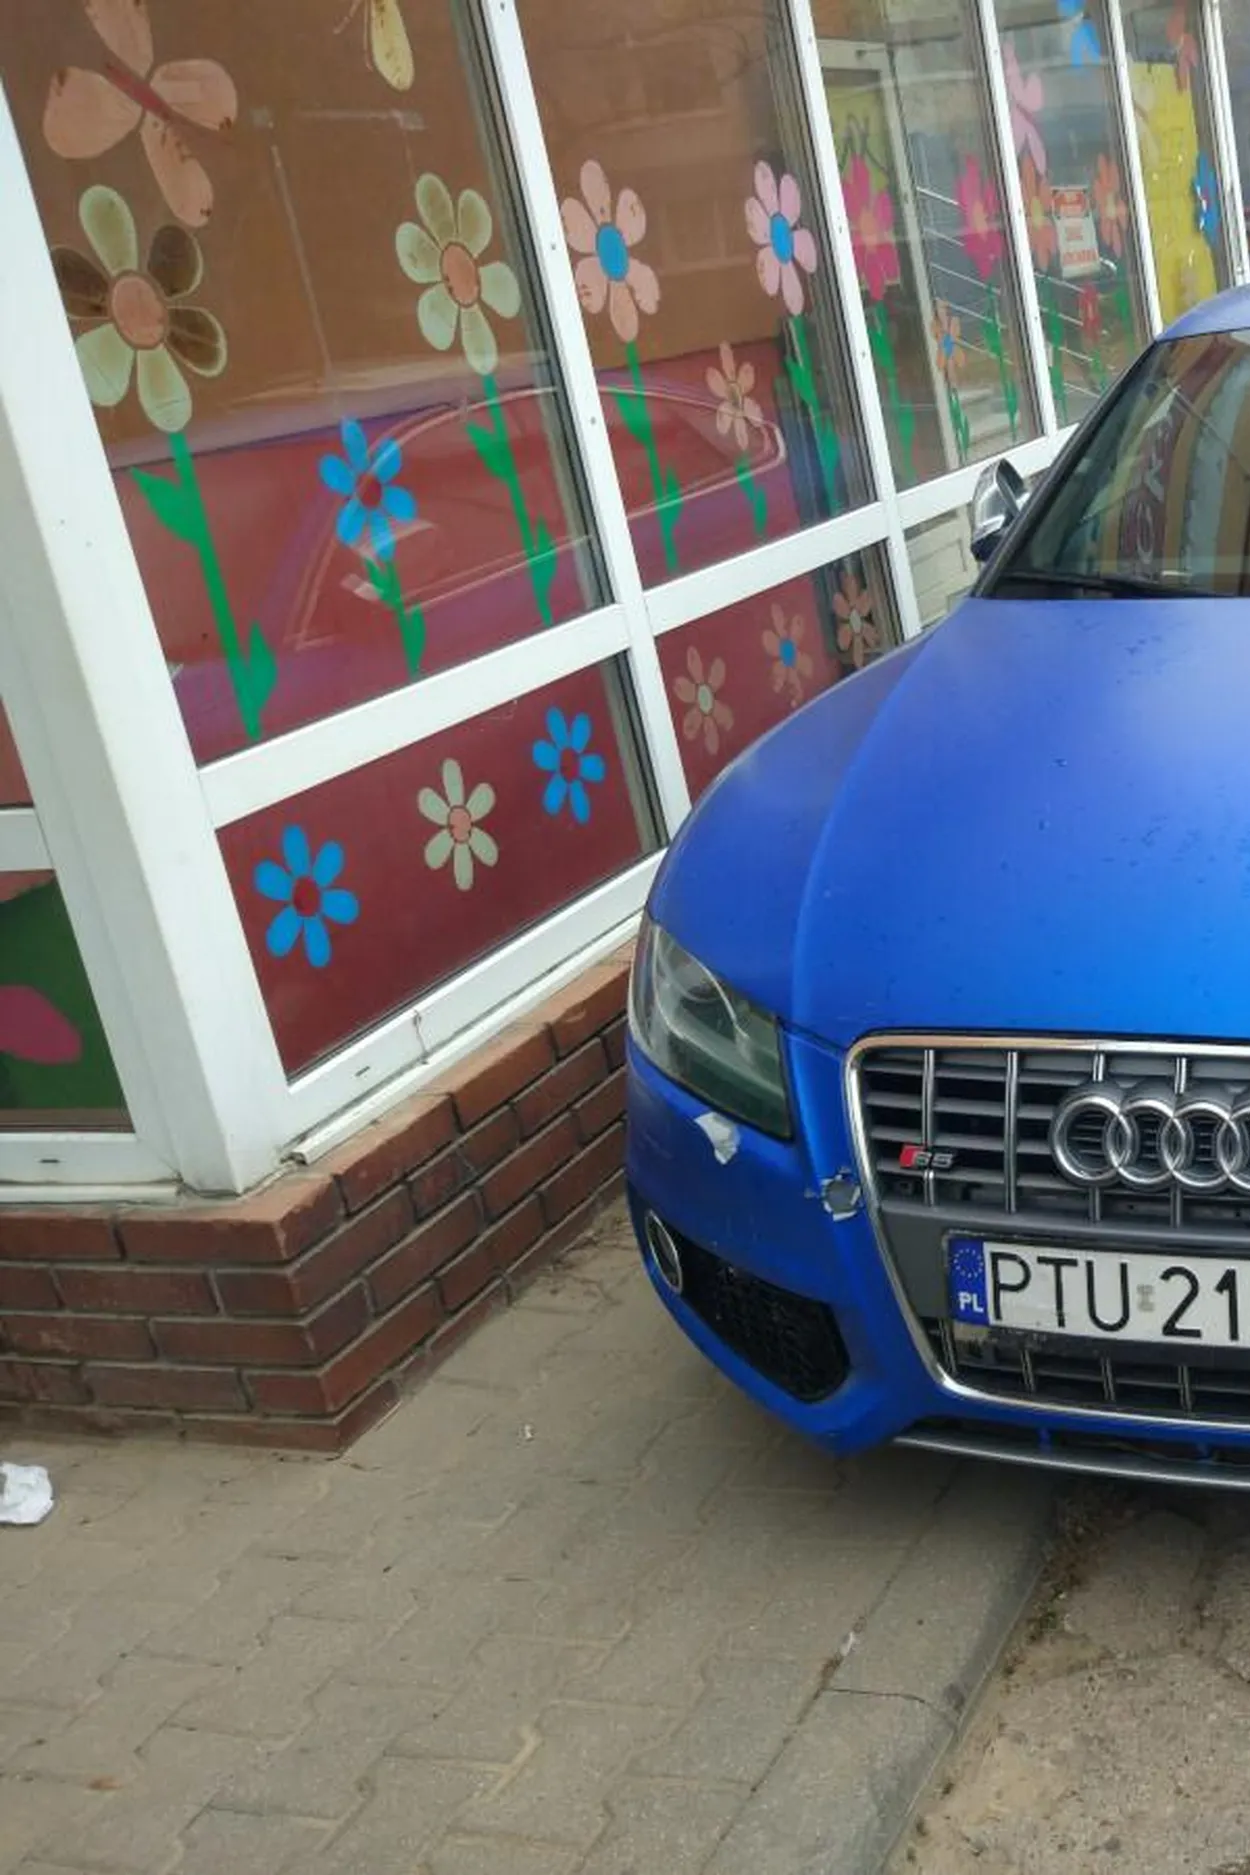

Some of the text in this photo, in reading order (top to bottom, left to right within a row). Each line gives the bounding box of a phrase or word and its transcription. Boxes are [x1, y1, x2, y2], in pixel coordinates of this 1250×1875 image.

[904, 1148, 955, 1169] S5
[958, 1291, 984, 1313] PL
[990, 1251, 1130, 1332] PTU
